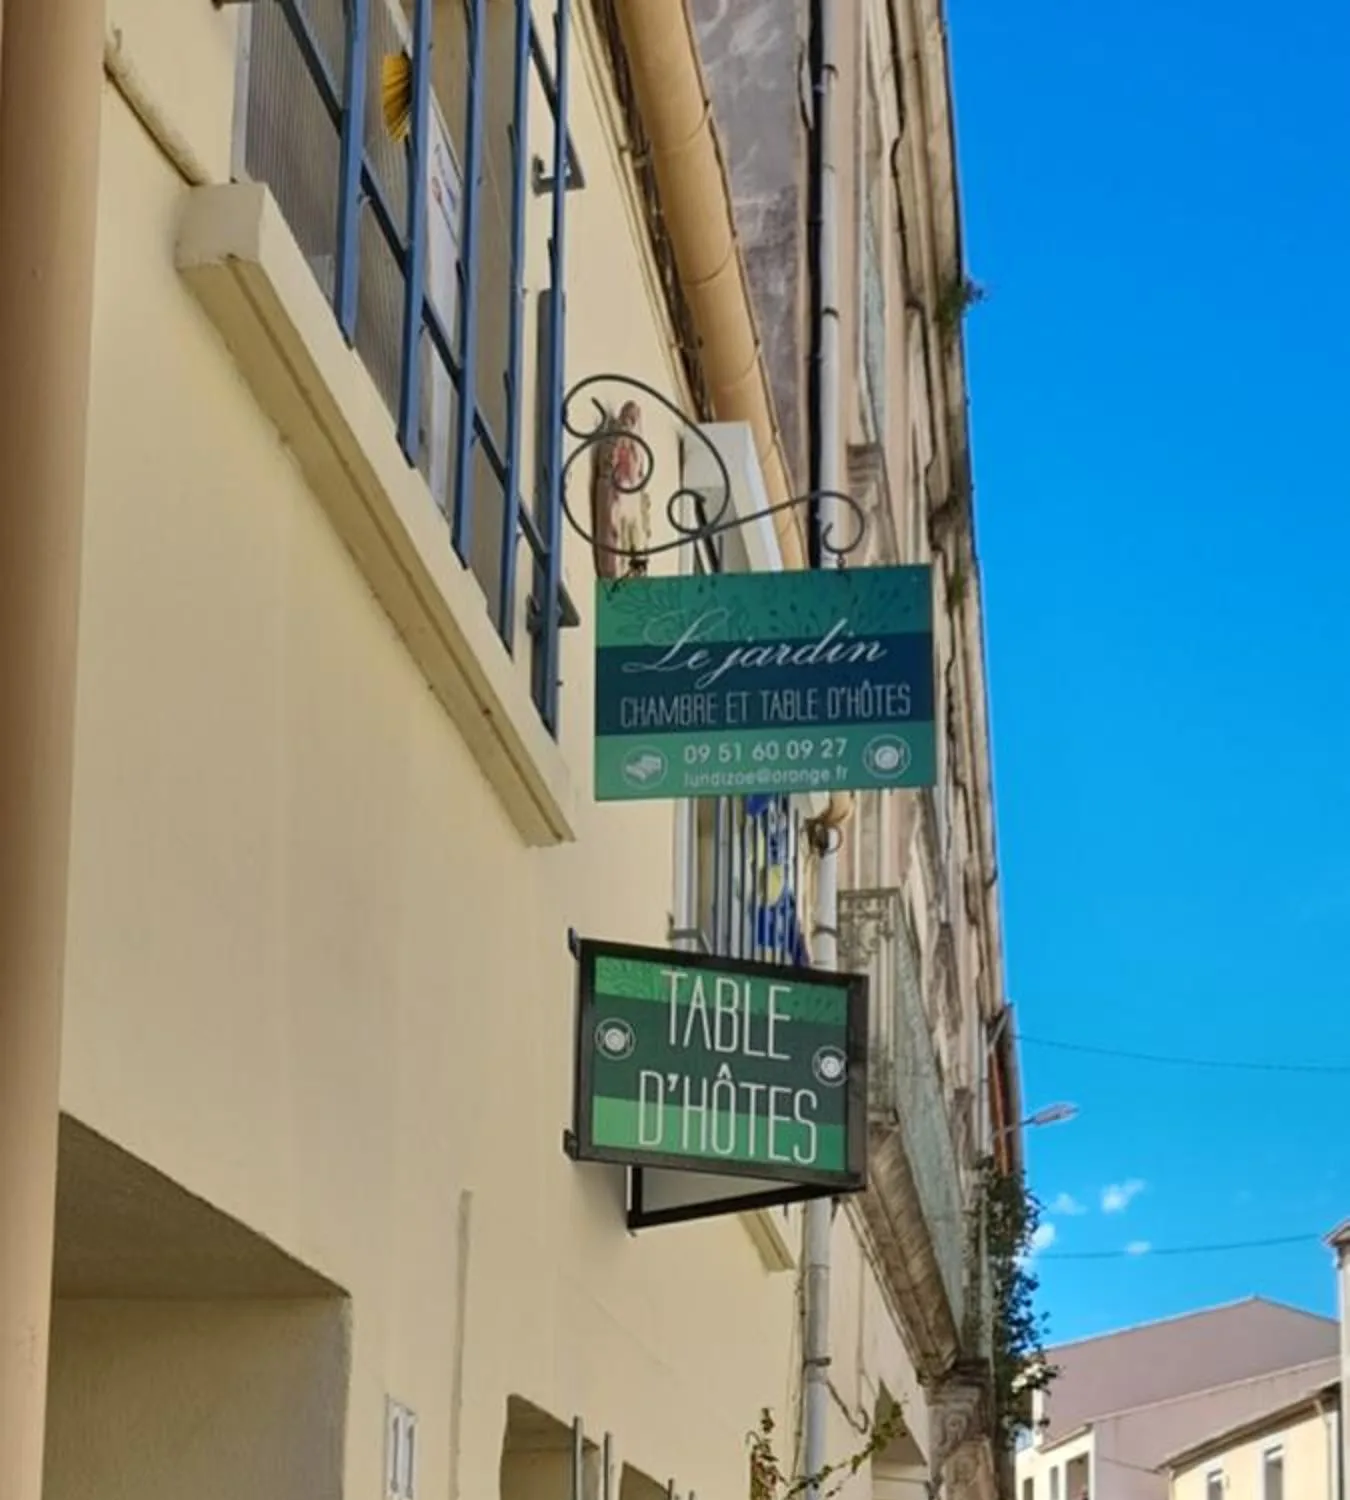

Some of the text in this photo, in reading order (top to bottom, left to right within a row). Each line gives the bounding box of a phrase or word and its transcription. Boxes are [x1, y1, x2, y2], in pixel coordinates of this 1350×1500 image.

[623, 607, 887, 689] Le jardin
[620, 680, 911, 728] CHAMBRE ET TABLE D'HÔTES
[684, 737, 848, 764] 09 51 60 09 27
[684, 764, 849, 788] lundizoe@orangefr
[660, 969, 792, 1060] TABLE
[637, 1062, 818, 1165] D'HÔTES
[390, 1416, 415, 1500] 11
